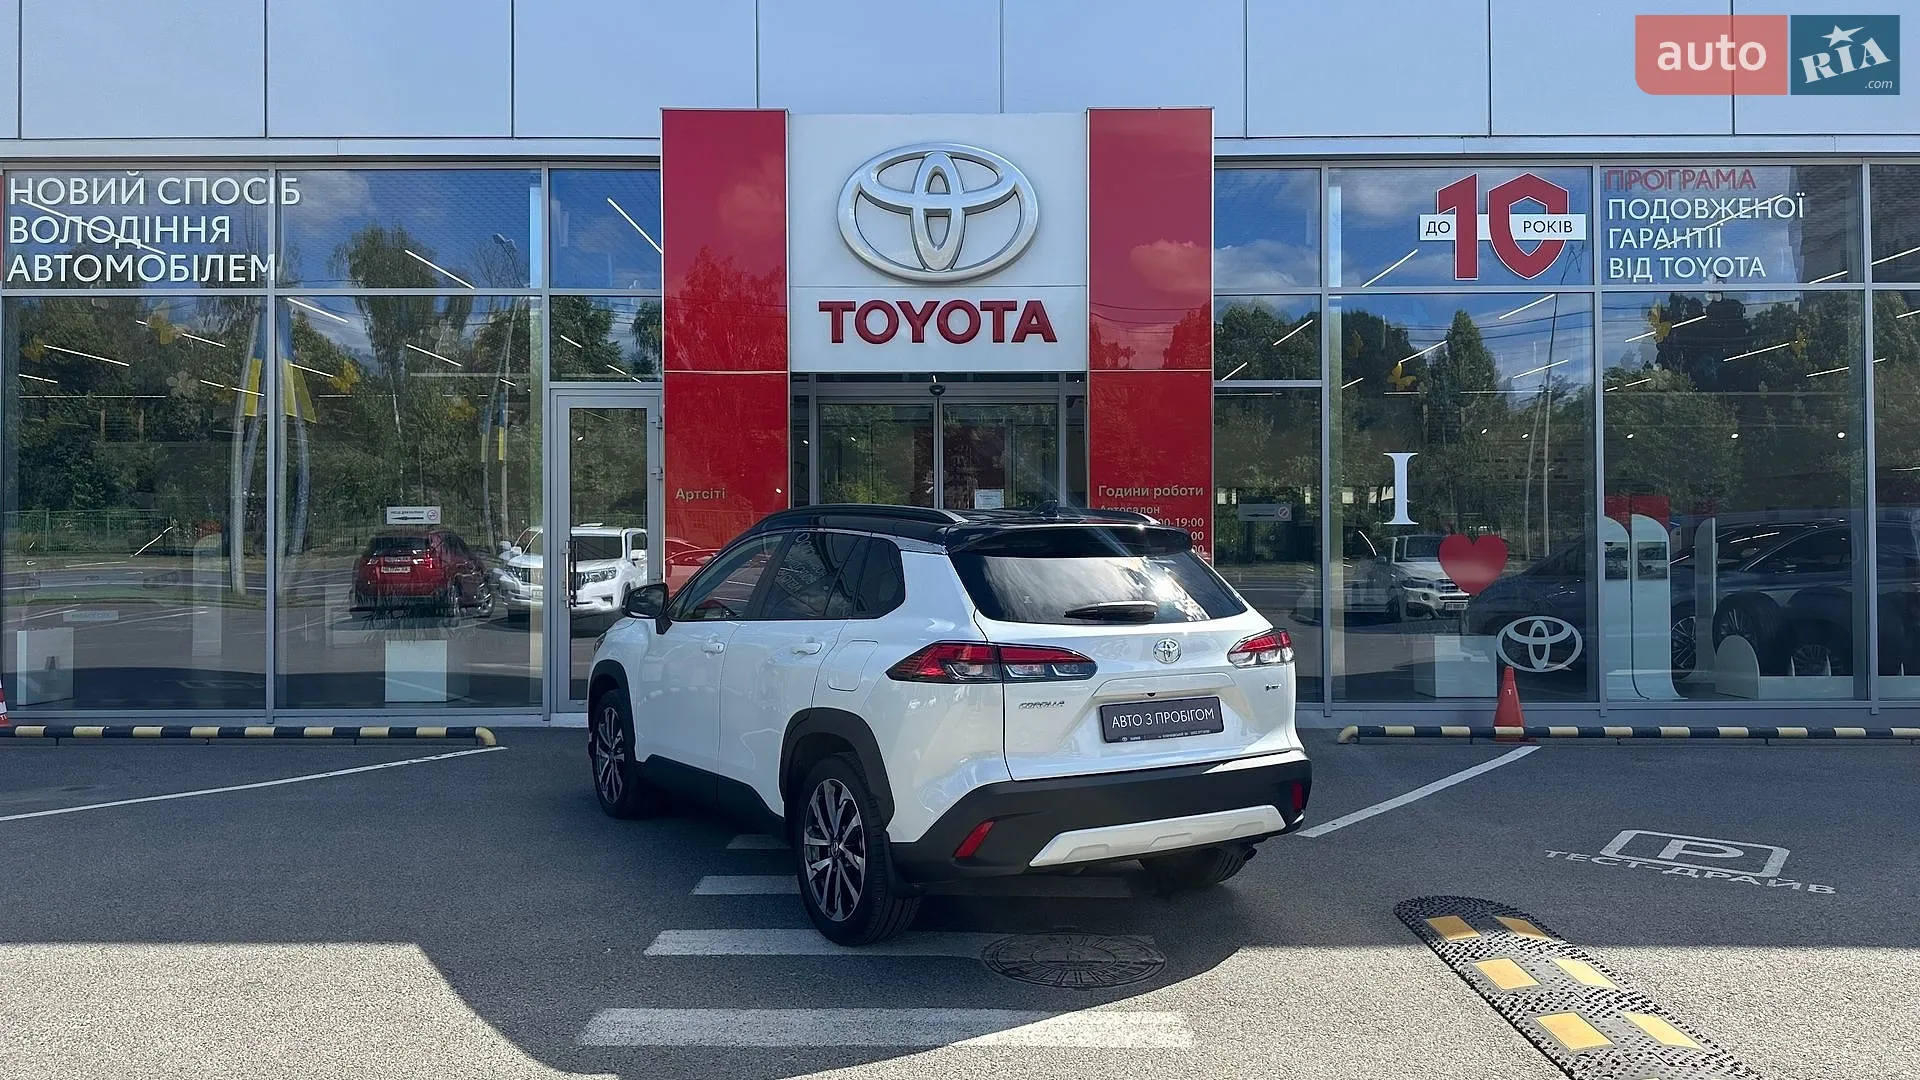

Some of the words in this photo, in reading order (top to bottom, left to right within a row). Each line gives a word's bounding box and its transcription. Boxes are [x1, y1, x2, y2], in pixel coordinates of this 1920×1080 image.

[10, 170, 146, 205] НОВИЙ
[157, 176, 300, 205] СПОСІБ
[1605, 169, 1756, 190] ПРОГРАМА
[1608, 192, 1806, 224] ПОДОВЖЕНОЇ
[9, 215, 230, 249] ВОЛОДІННЯ
[1425, 221, 1451, 236] ДО
[1523, 220, 1573, 233] РОКІВ
[1608, 222, 1725, 249] ГАРАНТІЇ
[7, 254, 275, 282] АВТОМОБІЛЕМ
[1609, 257, 1653, 283] ВІД
[1659, 256, 1767, 279] TOYOTA
[818, 300, 1058, 344] TOYOTA
[675, 487, 726, 502] Артсіті
[1098, 485, 1150, 498] Години
[1153, 485, 1204, 499] роботи
[1112, 713, 1143, 729] АВТО
[1155, 707, 1215, 725] ПРОБІГОМ
[1544, 849, 1837, 895] ТЕСТ-ДРАЙВ
